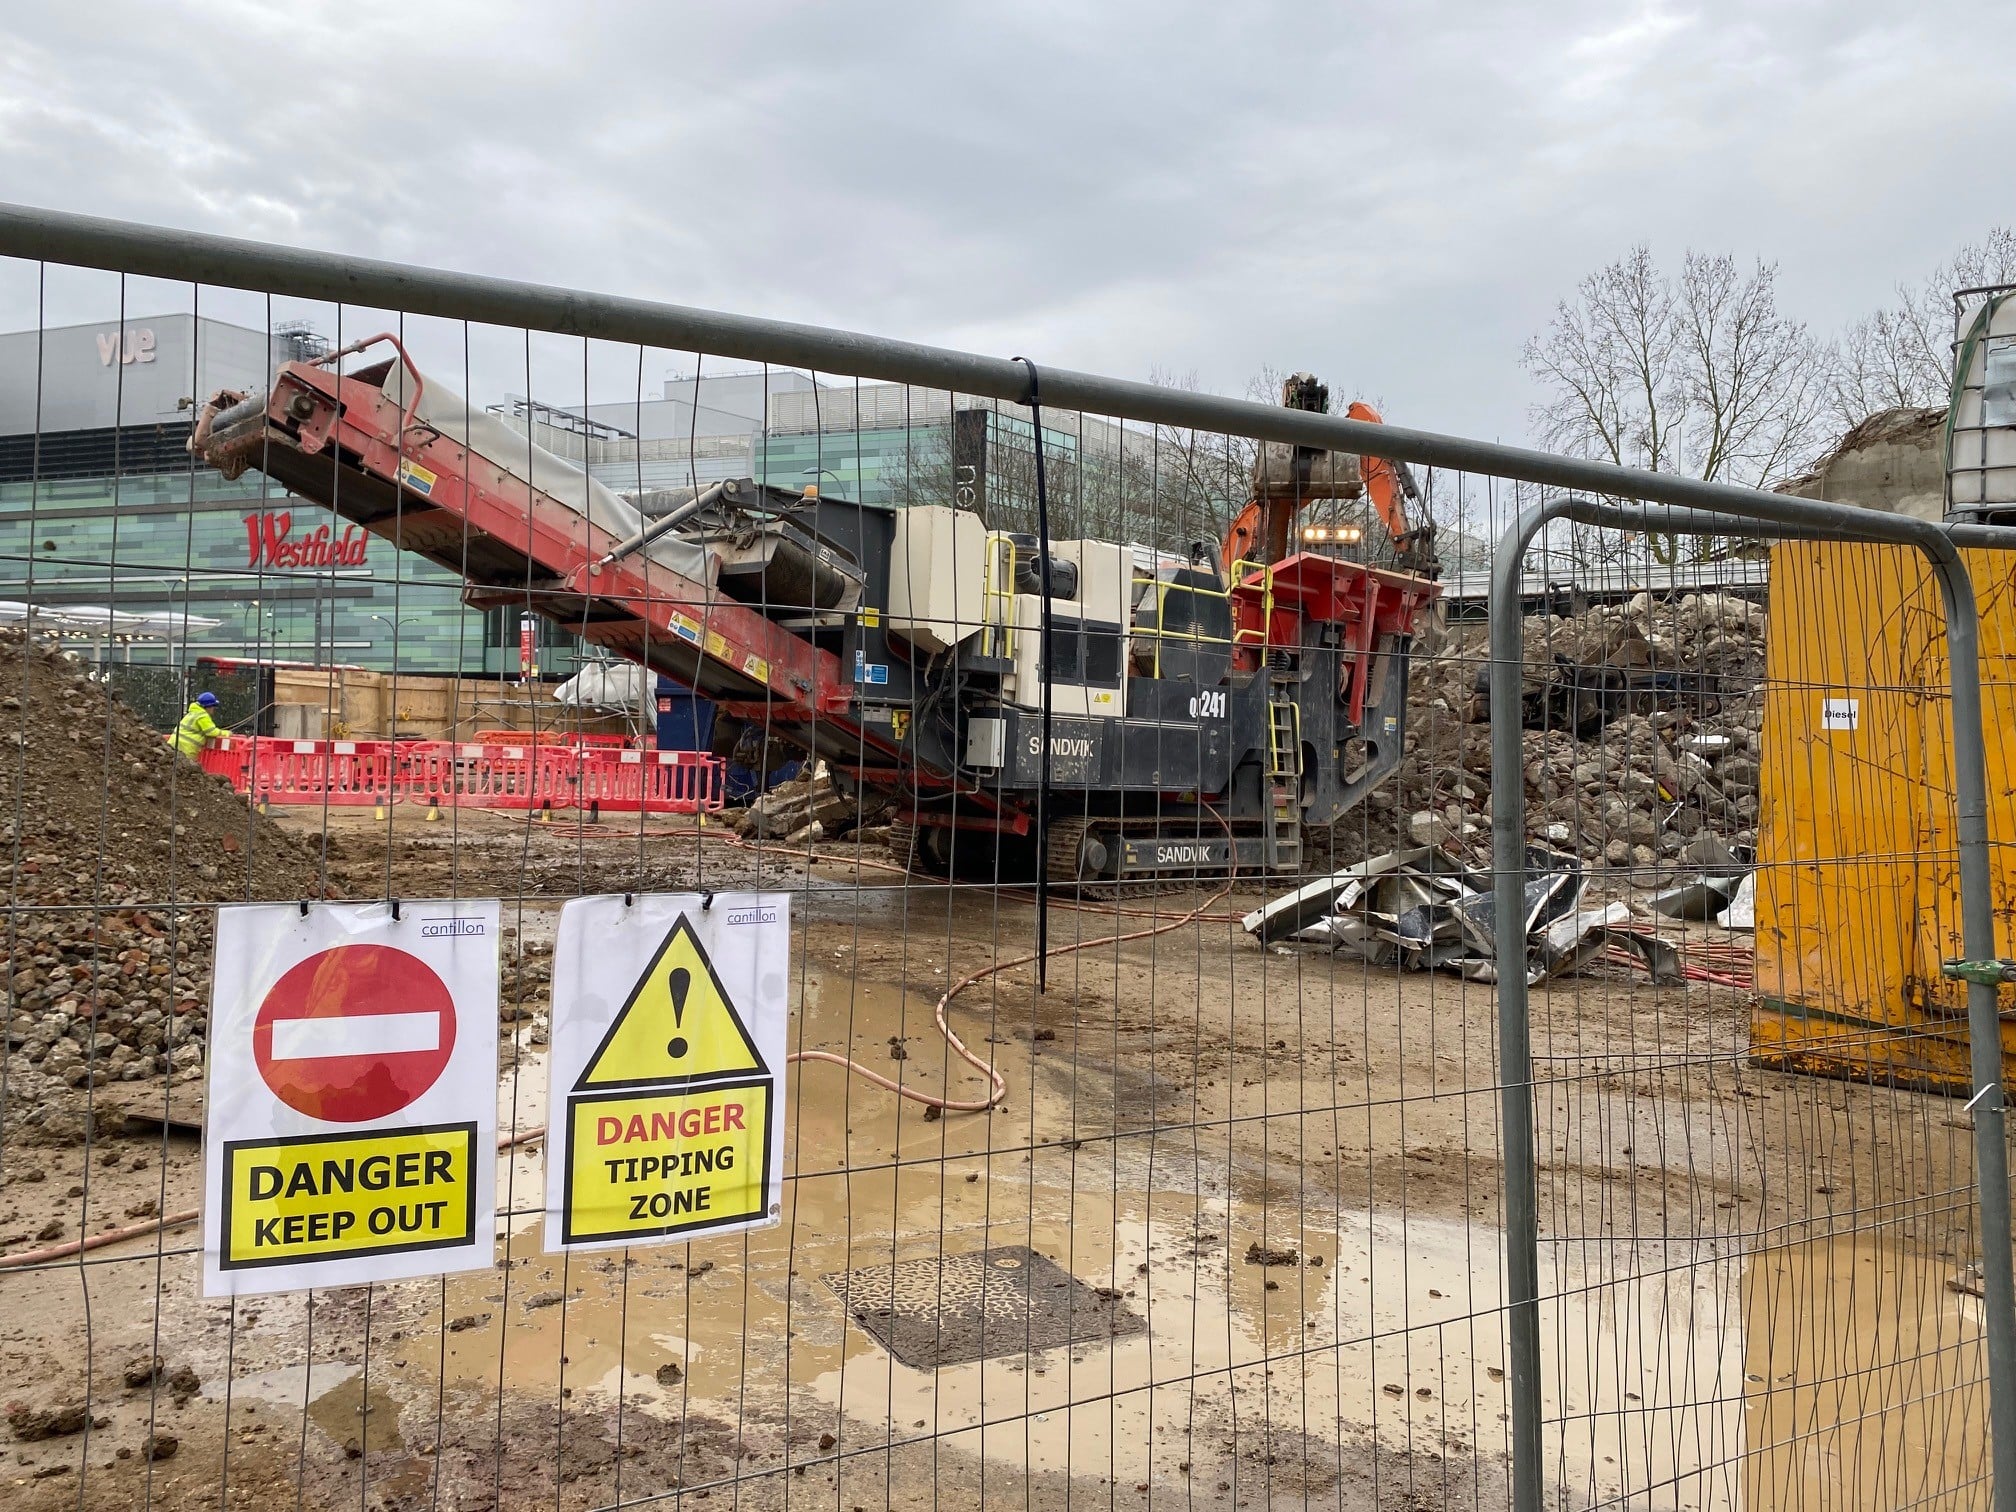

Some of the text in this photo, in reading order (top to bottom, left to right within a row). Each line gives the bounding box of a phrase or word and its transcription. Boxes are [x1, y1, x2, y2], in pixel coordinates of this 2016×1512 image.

[243, 511, 369, 568] Westfield
[1825, 710, 1856, 719] Diesel
[1029, 736, 1094, 757] SNDVIK
[1157, 845, 1211, 863] SANDVIK
[421, 918, 485, 936] cantillon
[727, 907, 776, 924] cantillon
[596, 1103, 747, 1146] DANGER
[249, 1150, 456, 1201] DANGER
[604, 1145, 734, 1184] TIPPING
[629, 1186, 711, 1220] ZONE
[254, 1200, 448, 1247] KEEP OUT
